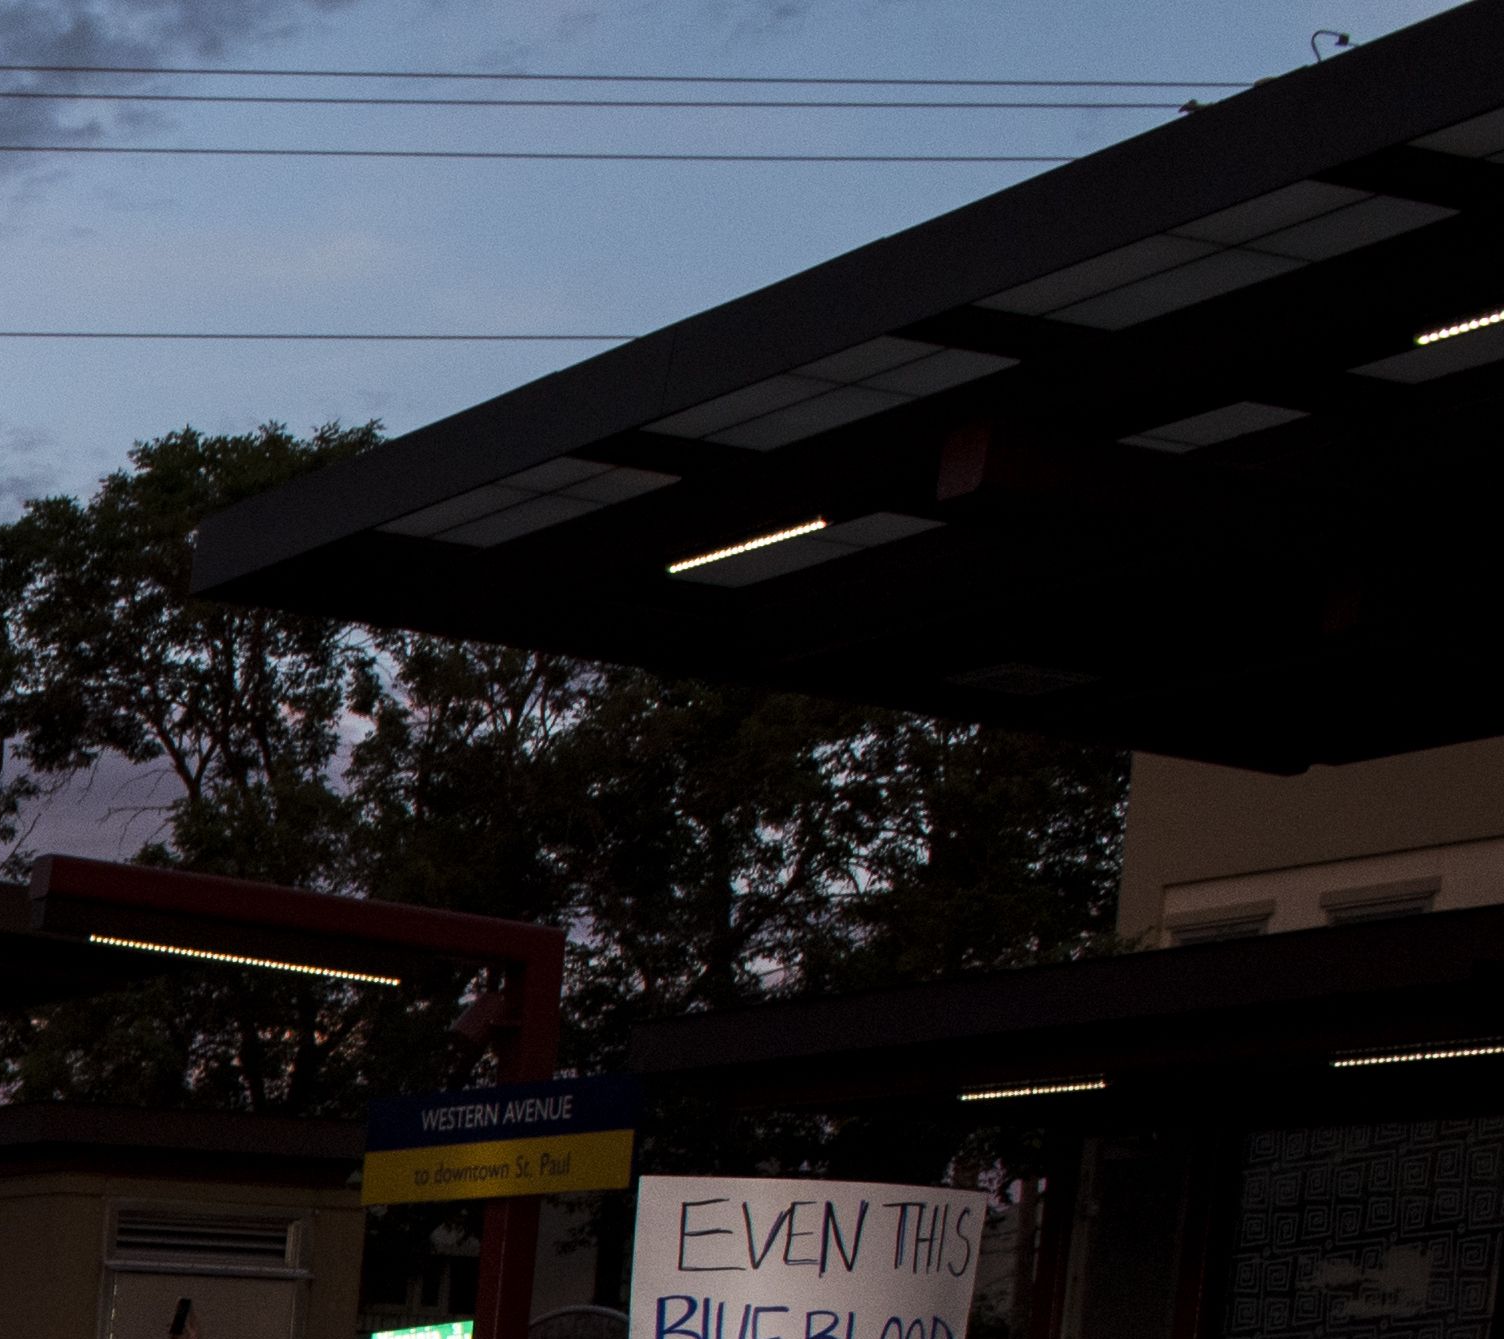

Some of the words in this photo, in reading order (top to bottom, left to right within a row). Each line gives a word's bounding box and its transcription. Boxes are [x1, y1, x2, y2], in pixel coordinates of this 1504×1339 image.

[421, 1101, 499, 1132] WESTERN
[502, 1094, 574, 1125] AVENUE
[414, 1168, 430, 1186] to
[433, 1160, 511, 1185] downtown
[539, 1151, 571, 1176] Paul
[678, 1198, 869, 1278] EVEN
[881, 1201, 972, 1277] THIS
